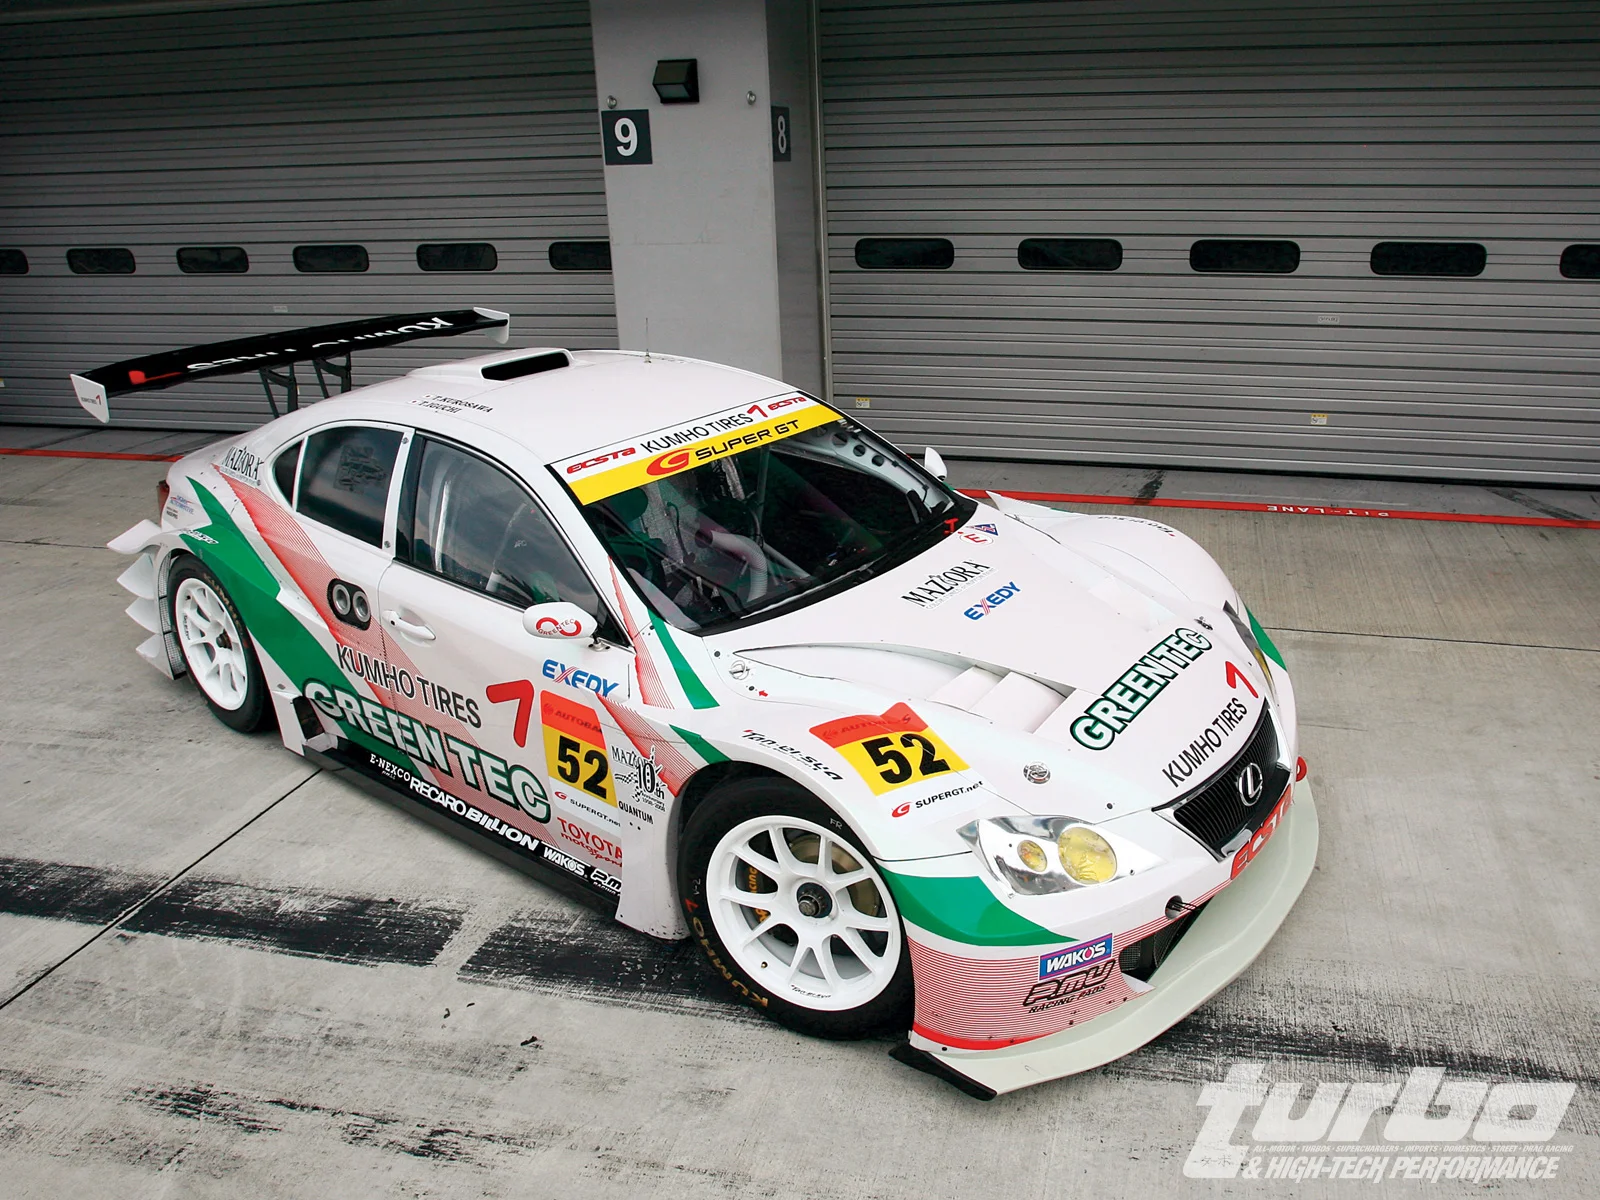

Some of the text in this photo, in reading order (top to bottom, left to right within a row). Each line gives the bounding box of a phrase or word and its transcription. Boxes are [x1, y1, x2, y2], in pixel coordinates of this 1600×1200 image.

[614, 117, 638, 157] 9
[777, 115, 788, 154] 8
[640, 426, 709, 453] KUMHO
[707, 413, 754, 438] TIRES
[695, 419, 801, 461] SUPER GT
[963, 581, 1023, 621] EXEDY
[538, 618, 576, 636] GREENTEC
[336, 642, 482, 729] KUMHO TIRES
[542, 659, 620, 698] EXEDY
[1069, 627, 1213, 751] GREENTEC
[555, 708, 603, 734] AUTOBA
[861, 733, 952, 784] 52
[1161, 697, 1248, 788] KUMHO TIRES
[369, 753, 411, 781] E-NEXCO
[557, 735, 609, 799] 52
[409, 776, 467, 816] RECARO
[618, 800, 654, 825] QUANTUM
[915, 780, 984, 809] SUPERGT.net
[465, 806, 540, 851] BILLION
[557, 816, 622, 860] TOYOTA
[829, 817, 843, 830] FR
[692, 916, 769, 1008] KUMHO
[1028, 995, 1076, 1013] RACING
